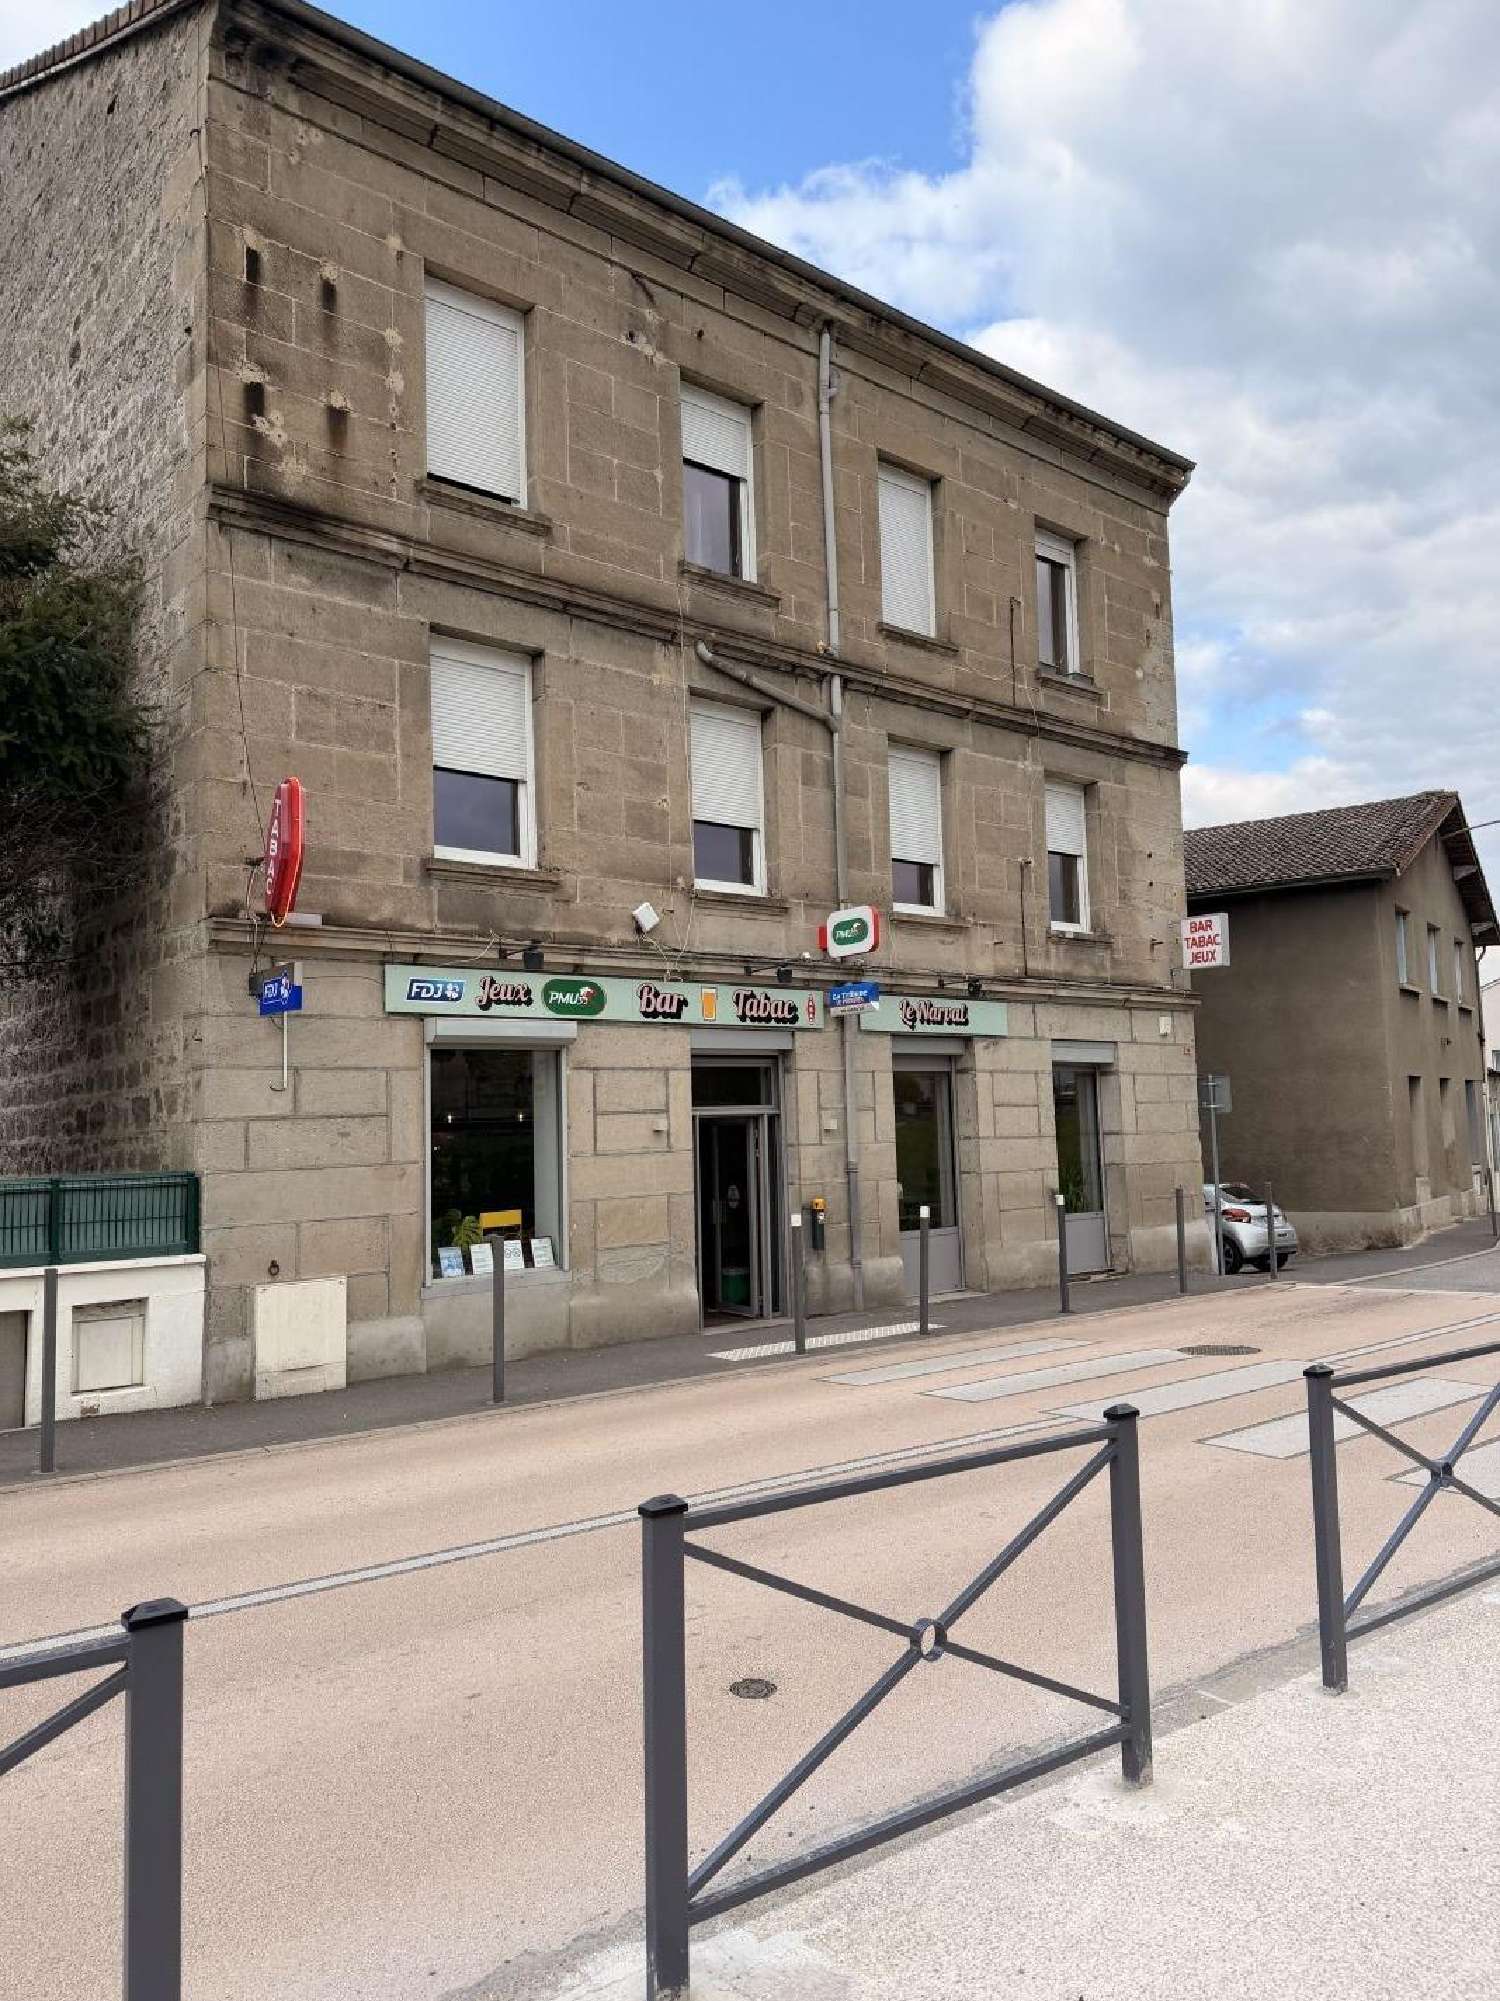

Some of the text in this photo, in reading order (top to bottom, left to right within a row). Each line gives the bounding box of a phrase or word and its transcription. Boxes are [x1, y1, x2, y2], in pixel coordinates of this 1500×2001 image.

[266, 798, 281, 895] TABAC
[1190, 920, 1212, 932] BAR
[1184, 934, 1221, 949] TABAC
[1190, 949, 1216, 965] JEUX
[411, 983, 442, 998] FDJ
[475, 976, 531, 1008] Jeux
[549, 992, 579, 1005] PMU
[638, 984, 687, 1017] Bar
[733, 989, 797, 1022] Tabac
[901, 1000, 968, 1029] Le Narval
